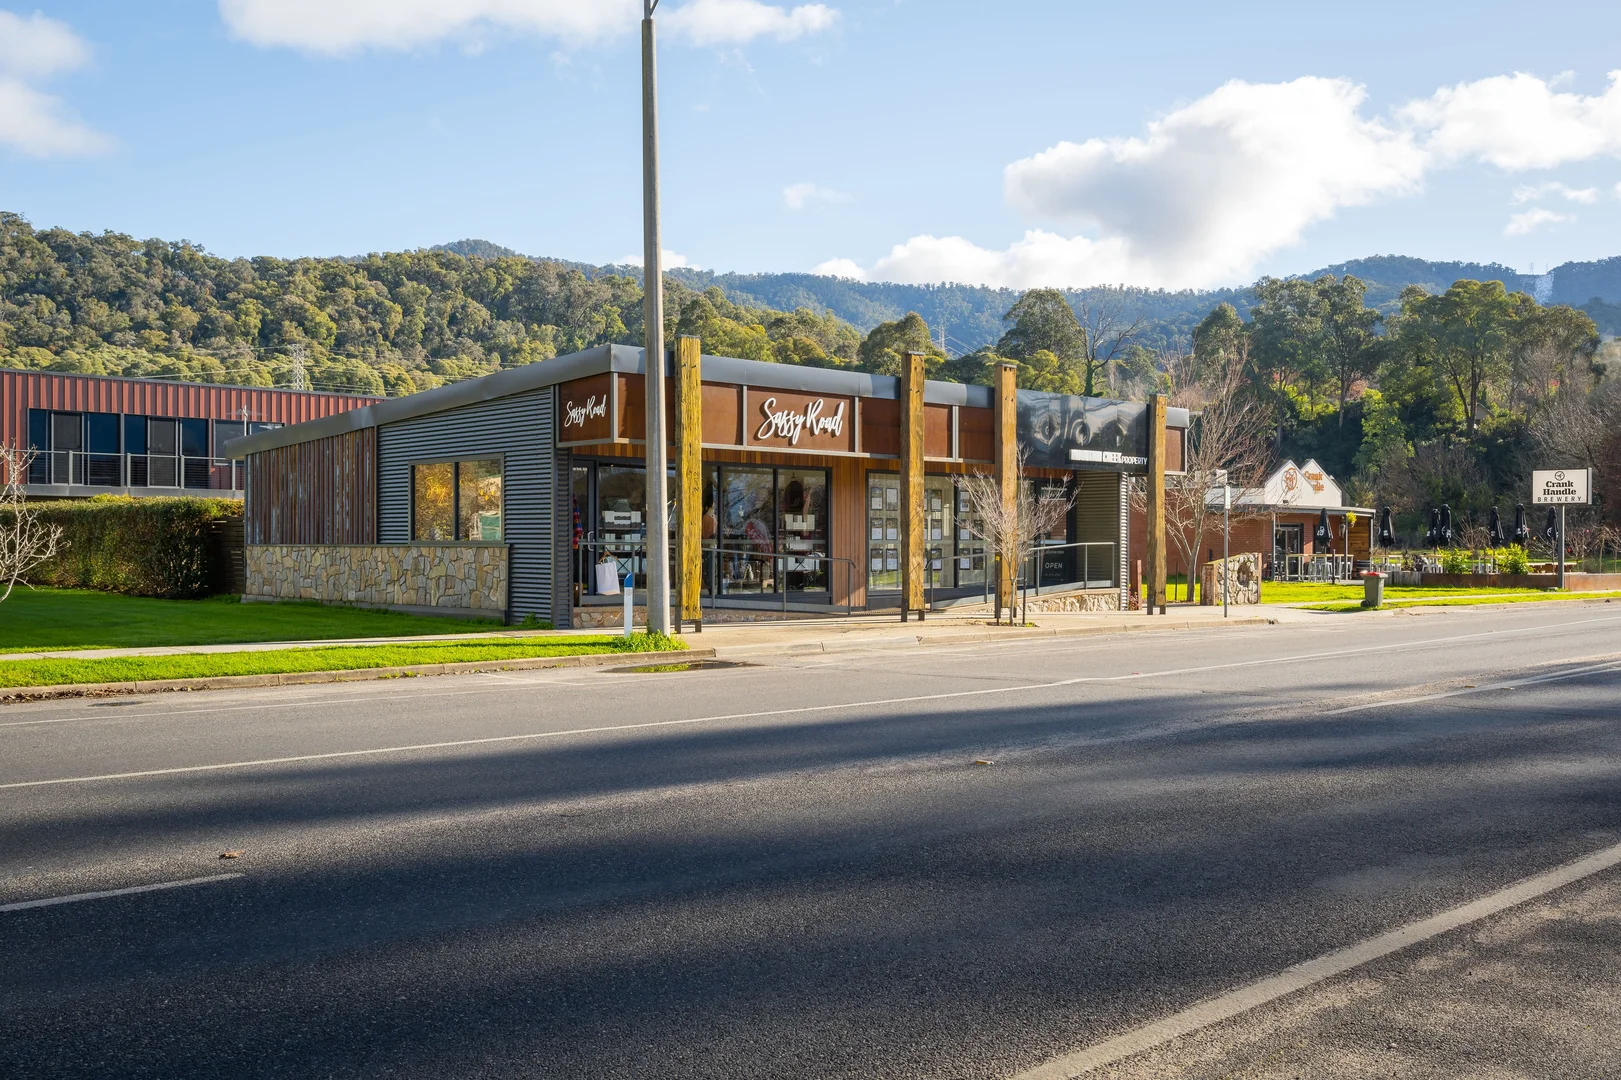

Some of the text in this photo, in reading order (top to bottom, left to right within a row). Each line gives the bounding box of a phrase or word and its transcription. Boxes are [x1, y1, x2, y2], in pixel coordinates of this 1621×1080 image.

[564, 394, 607, 427] Sassy Road
[758, 397, 844, 445] Sassy Road
[1121, 455, 1148, 465] PROPERTY
[1545, 480, 1574, 488] Crank
[1542, 488, 1577, 496] Handle
